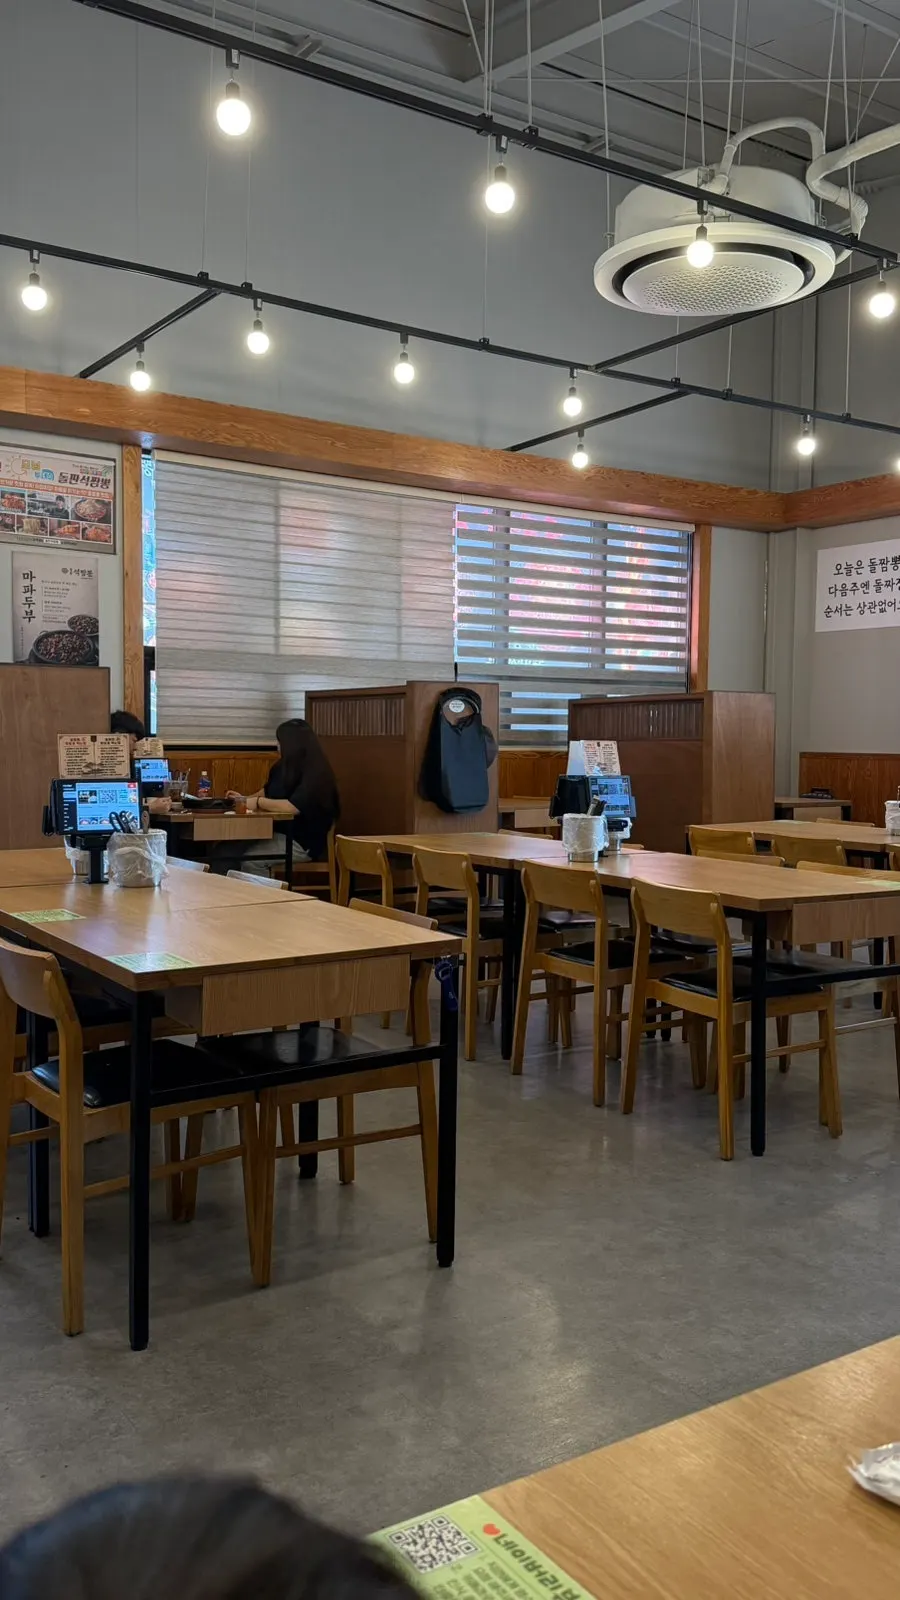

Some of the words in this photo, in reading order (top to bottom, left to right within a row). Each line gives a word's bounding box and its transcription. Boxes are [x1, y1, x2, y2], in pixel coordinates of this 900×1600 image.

[833, 559, 864, 577] 오늘은
[868, 555, 900, 574] 돌짬뽕
[22, 570, 36, 624] 마파두부
[828, 580, 870, 598] 다음주엔
[824, 603, 854, 618] 순서는
[856, 598, 900, 615] 상관없어
